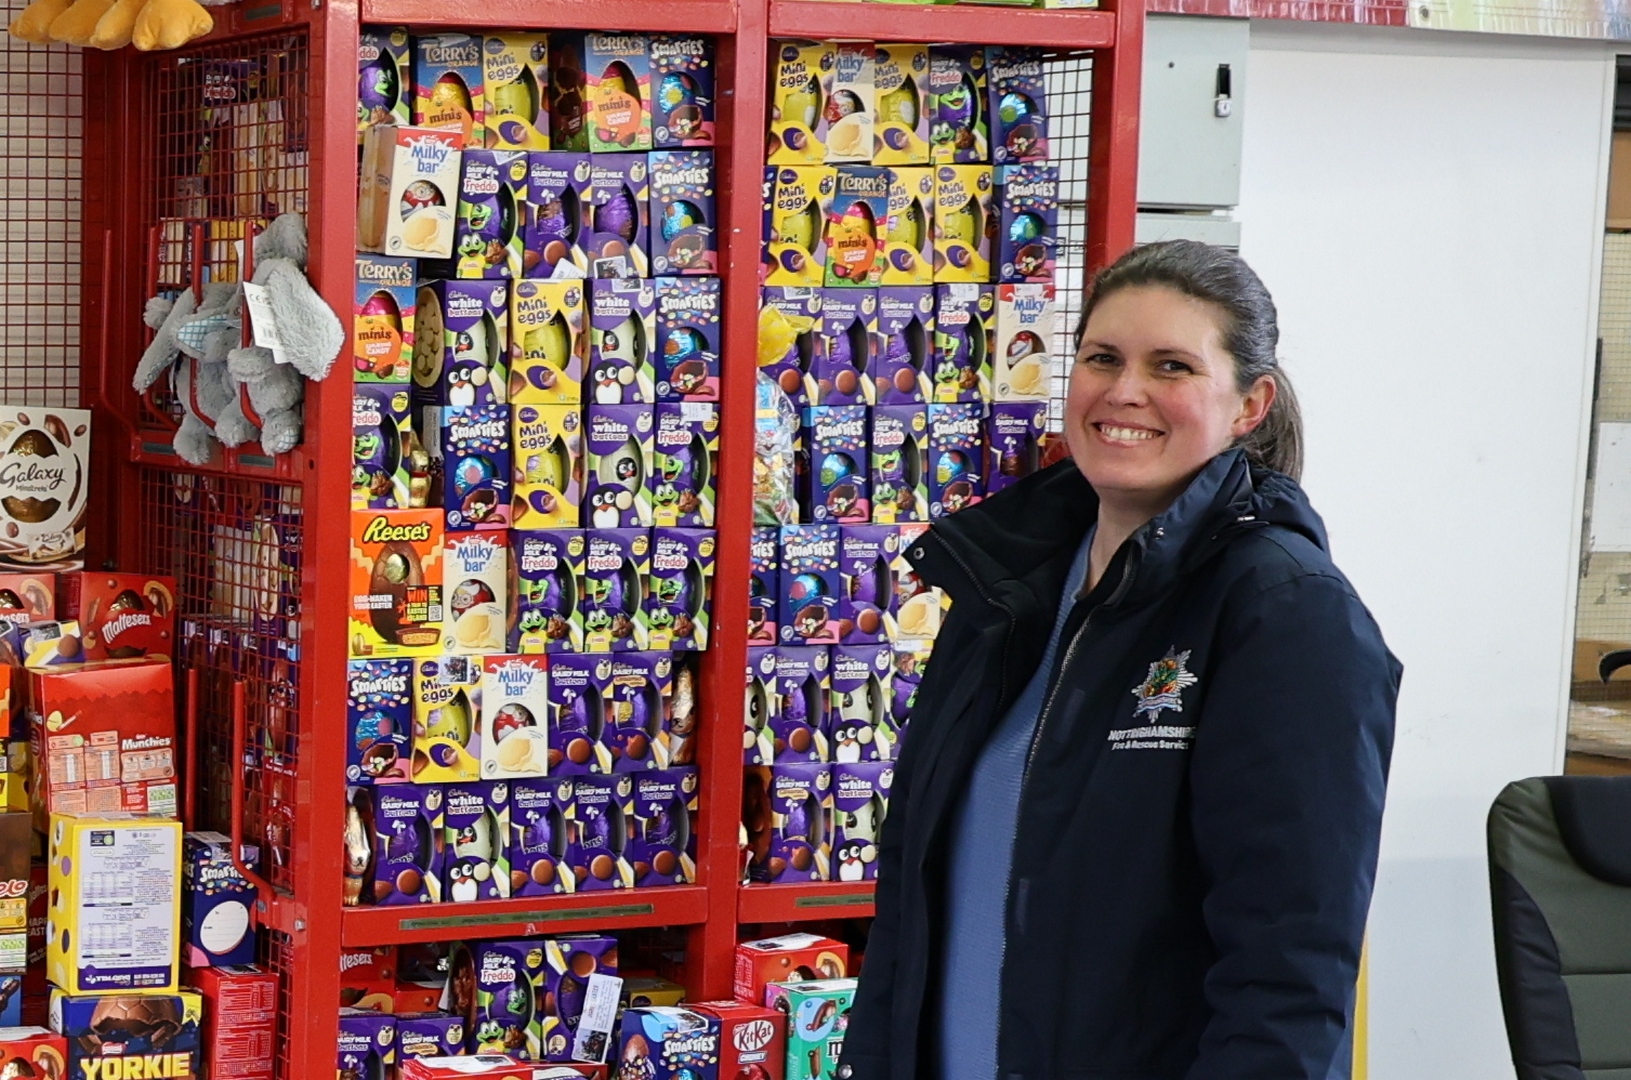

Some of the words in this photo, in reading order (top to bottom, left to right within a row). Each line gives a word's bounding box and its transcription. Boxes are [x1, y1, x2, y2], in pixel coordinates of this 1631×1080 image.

[486, 52, 515, 70] Mini
[488, 65, 519, 81] eggs
[781, 61, 806, 76] Mini
[874, 62, 899, 78] Mini
[779, 73, 809, 88] eggs
[837, 70, 856, 83] bar
[874, 74, 903, 89] eggs
[930, 72, 961, 84] Freddo
[598, 98, 631, 112] minis
[429, 108, 462, 122] minis
[411, 145, 449, 163] Milky
[417, 159, 439, 173] bar
[464, 180, 497, 193] Freddo
[778, 184, 805, 198] Mini
[889, 183, 906, 197] ini
[938, 181, 964, 195] Mini
[777, 196, 807, 210] eggs
[889, 197, 910, 210] ggs
[939, 193, 967, 207] eggs
[838, 237, 867, 248] minis
[449, 299, 483, 308] white
[517, 297, 548, 313] Mini
[594, 298, 630, 307] white
[1014, 299, 1046, 313] Milky
[448, 309, 483, 317] buttons
[518, 310, 552, 325] eggs
[594, 308, 630, 316] buttons
[1020, 311, 1038, 324] bar
[940, 313, 968, 325] Freddo
[358, 327, 392, 341] minis
[353, 414, 380, 425] reddo
[520, 421, 548, 438] Mini
[593, 423, 628, 432] white
[520, 434, 552, 449] eggs
[592, 433, 628, 441] buttons
[659, 432, 690, 445] Freddo
[874, 433, 903, 445] Freddo
[1, 462, 66, 490] Galaxy
[364, 516, 431, 541] Reese's
[457, 544, 494, 560] Milky
[464, 559, 486, 573] bar
[523, 557, 555, 569] Freddo
[589, 557, 620, 569] Freddo
[655, 556, 687, 568] Freddo
[407, 589, 428, 602] WIN
[835, 661, 869, 670] white
[498, 669, 534, 685] Milky
[835, 671, 869, 679] buttons
[554, 678, 587, 686] buttons
[421, 688, 454, 703] eggs
[505, 684, 527, 696] bar
[122, 736, 171, 751] Munchies
[1132, 740, 1158, 750] Rescue
[839, 781, 872, 789] white
[448, 796, 484, 805] white
[838, 790, 873, 798] buttons
[384, 809, 417, 818] buttons
[448, 806, 484, 815] buttons
[340, 953, 373, 972] ltesers
[481, 970, 514, 983] Freddo
[739, 1022, 772, 1050] KitKat
[80, 1053, 191, 1080] YORKIE
